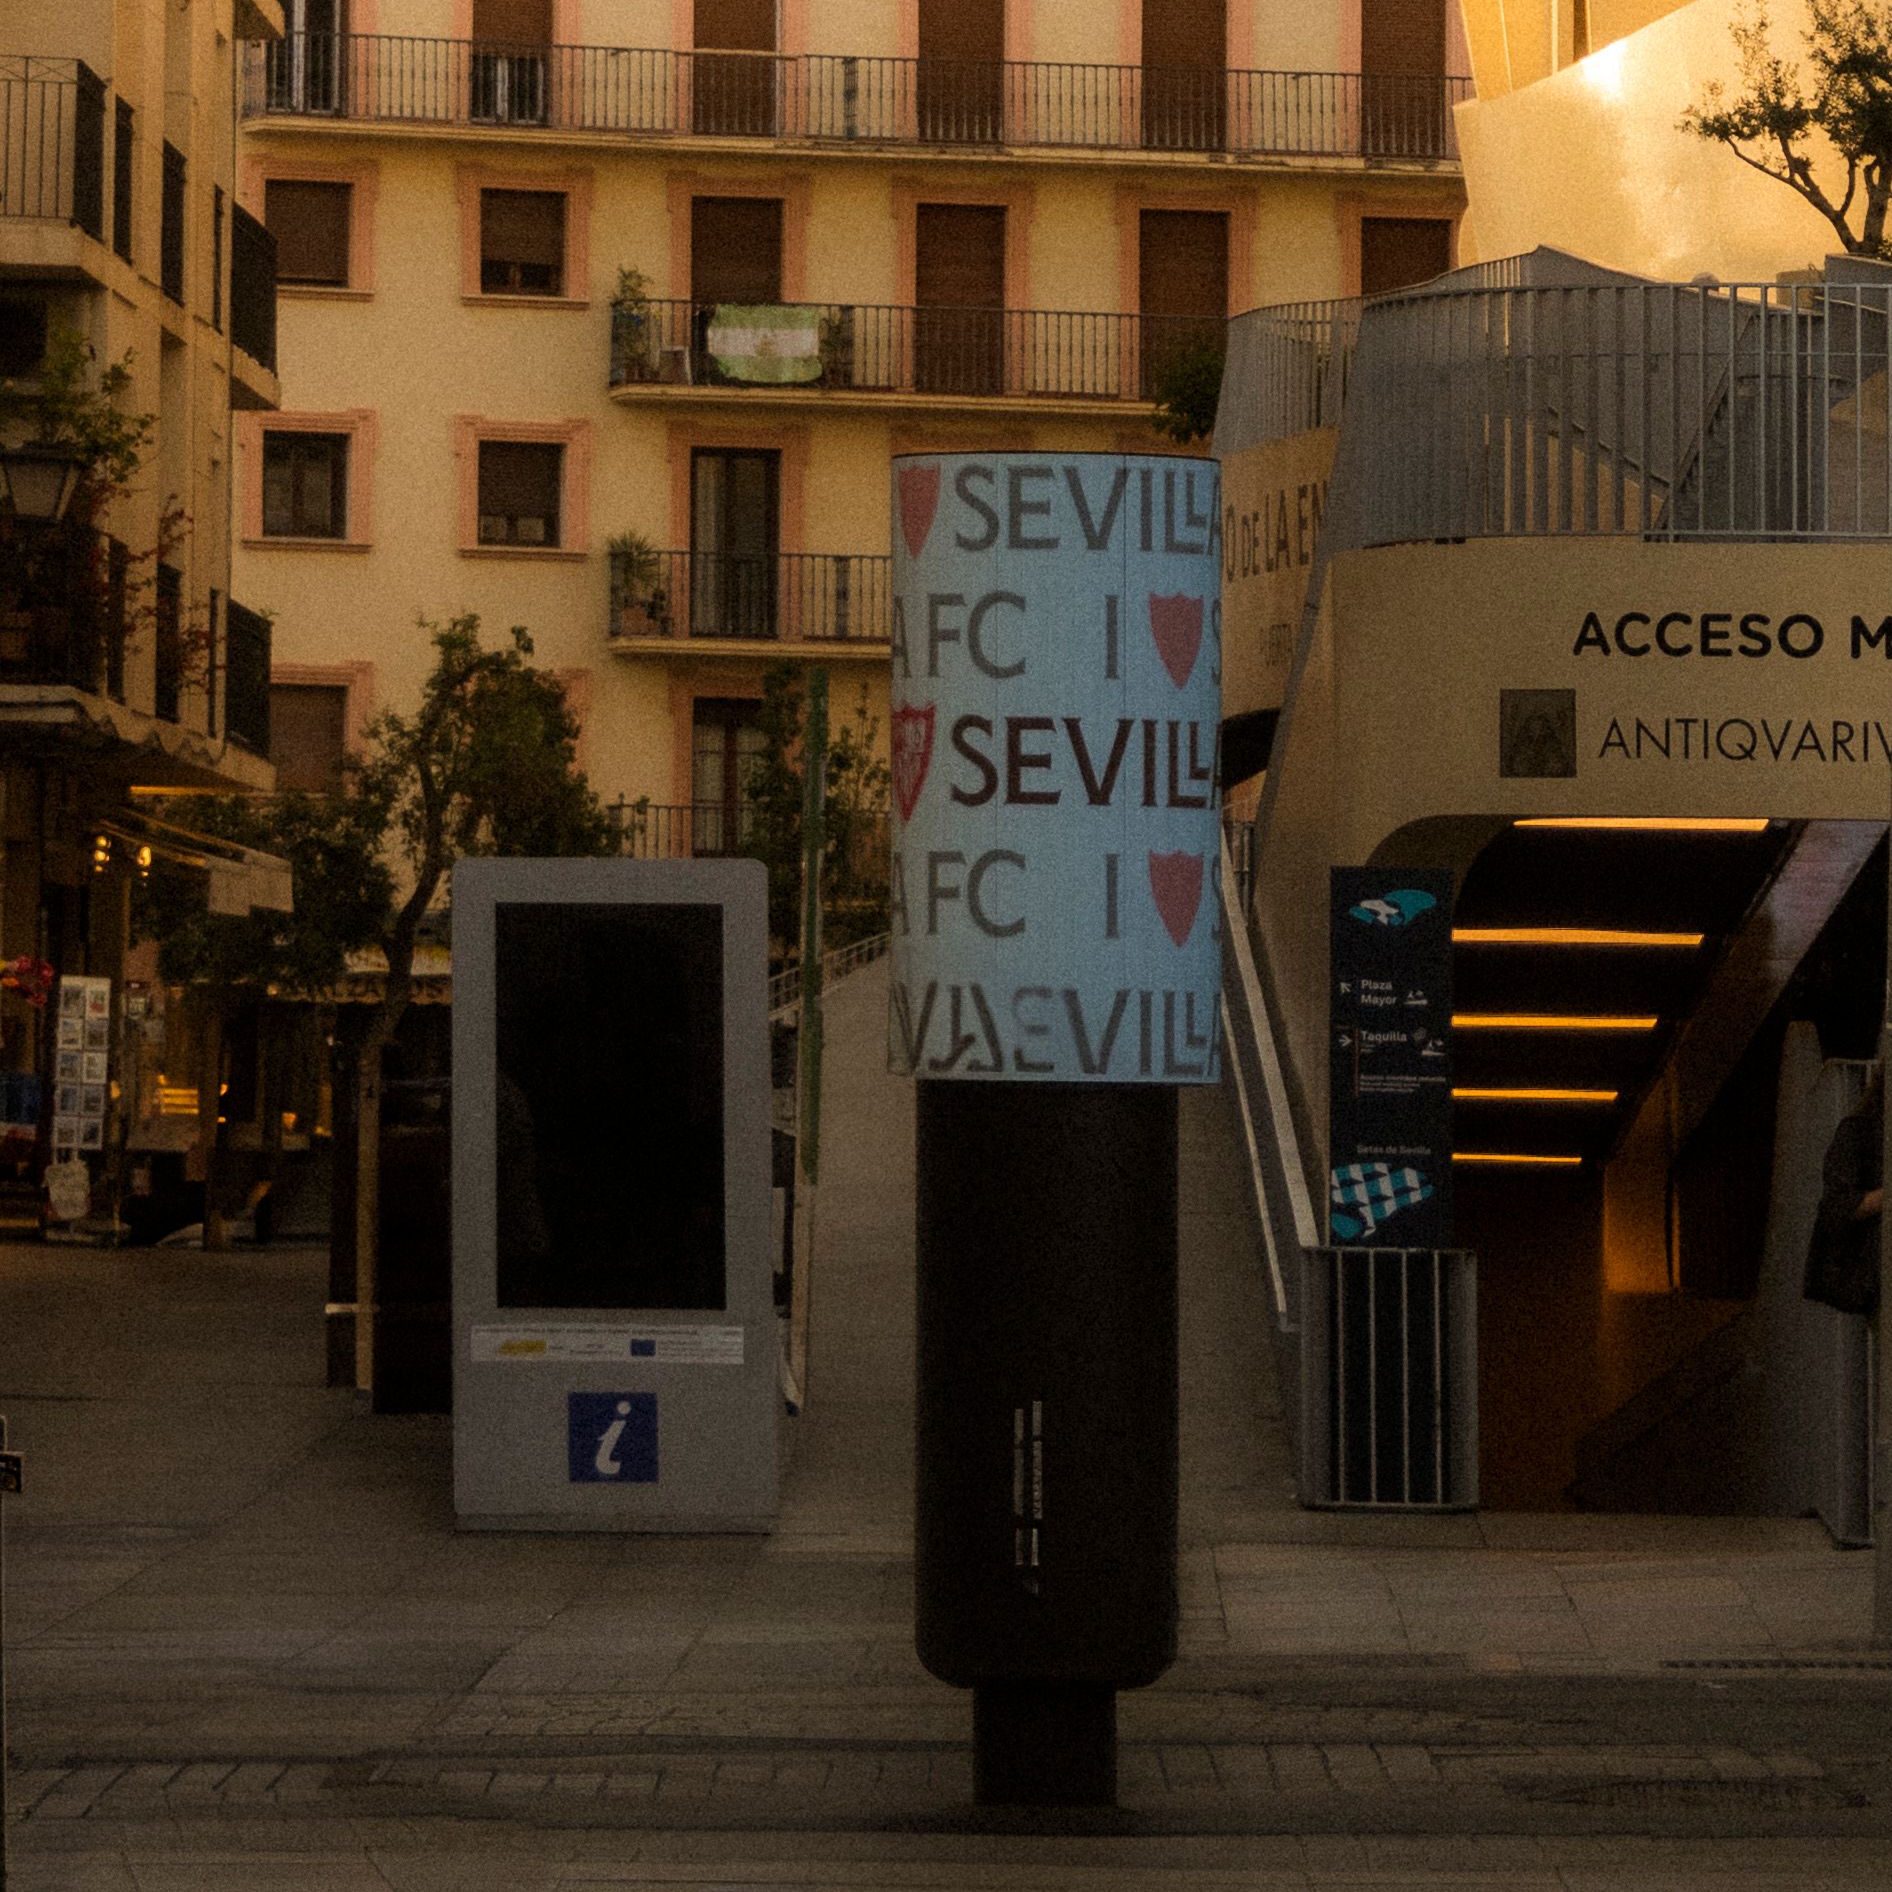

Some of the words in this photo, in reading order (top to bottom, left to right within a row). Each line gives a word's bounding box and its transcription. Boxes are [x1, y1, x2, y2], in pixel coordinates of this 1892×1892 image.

[1242, 511, 1260, 579] DE
[1264, 489, 1292, 574] LA
[926, 590, 1028, 681] FC
[1104, 592, 1120, 681] I
[1572, 611, 1825, 659] ACCESO
[926, 848, 1027, 938] FC
[1104, 852, 1120, 940] I
[1359, 978, 1394, 991] Plaza
[1359, 993, 1398, 1008] Mayor
[1359, 1029, 1408, 1045] Taquilla
